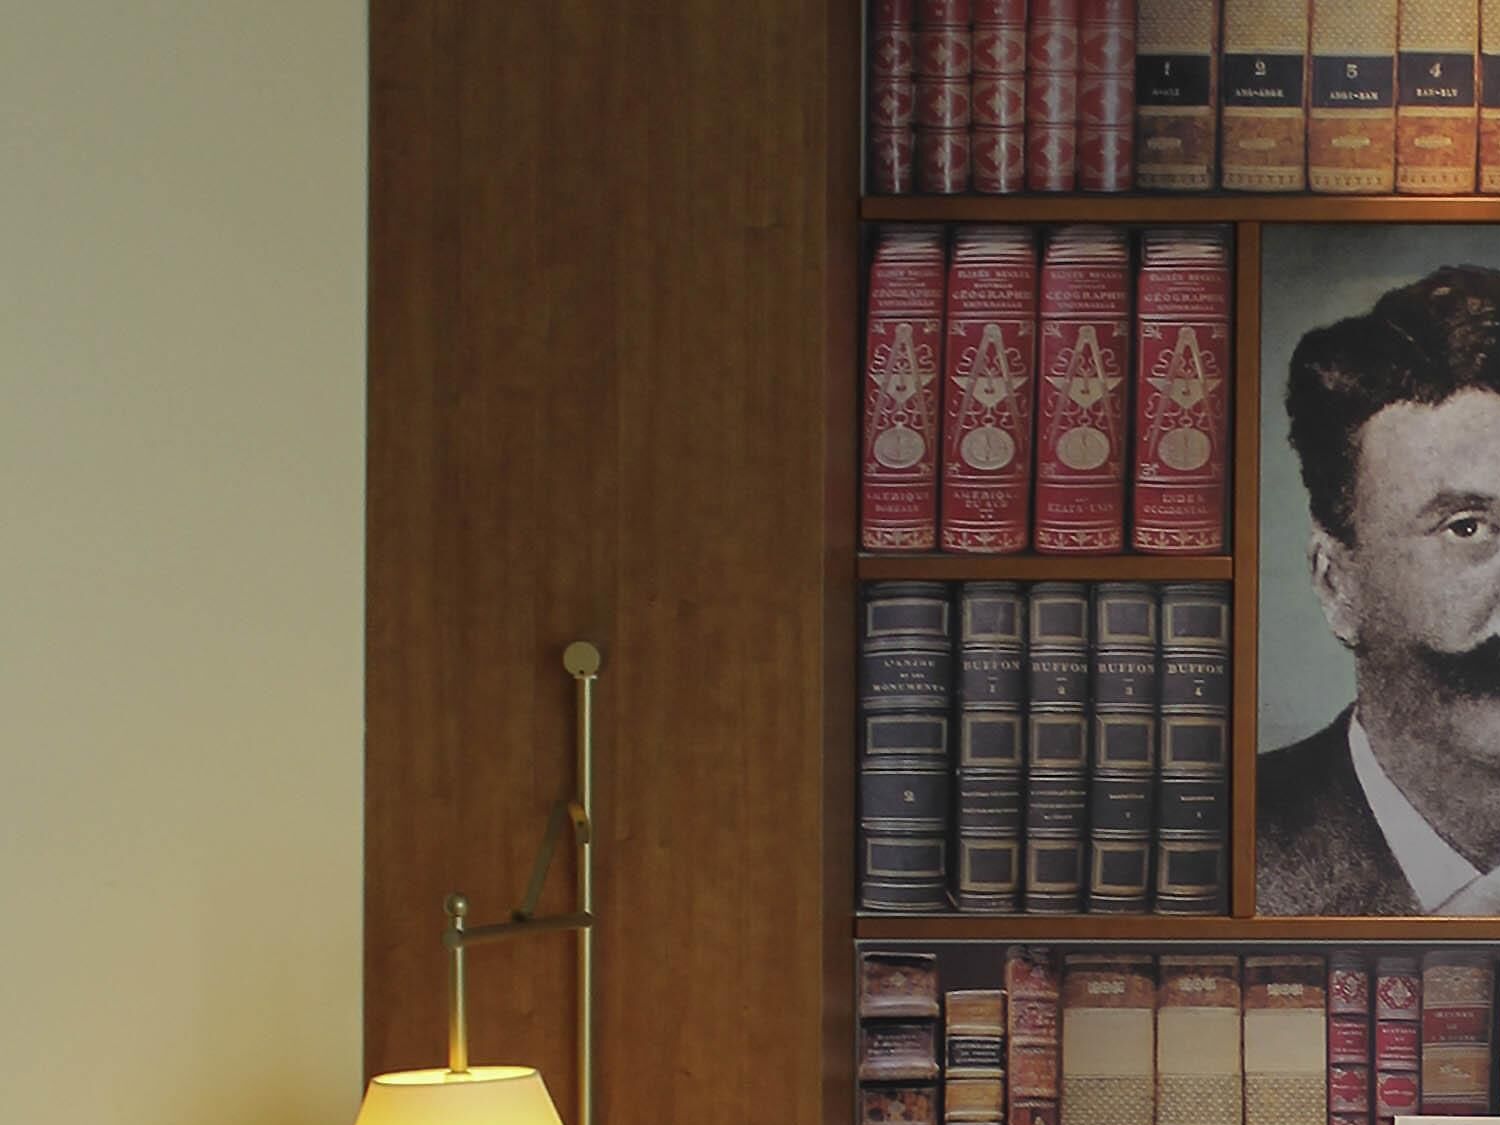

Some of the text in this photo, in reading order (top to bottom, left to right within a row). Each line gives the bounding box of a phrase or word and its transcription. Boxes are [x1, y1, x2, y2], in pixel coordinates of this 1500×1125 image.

[1254, 61, 1266, 76] 2
[1429, 62, 1441, 78] 4
[963, 660, 1020, 671] BUFFON
[1032, 661, 1088, 673] BUFFON
[1099, 662, 1155, 673] BUFFON
[1167, 663, 1225, 674] BUFFON
[903, 789, 915, 803] 2
